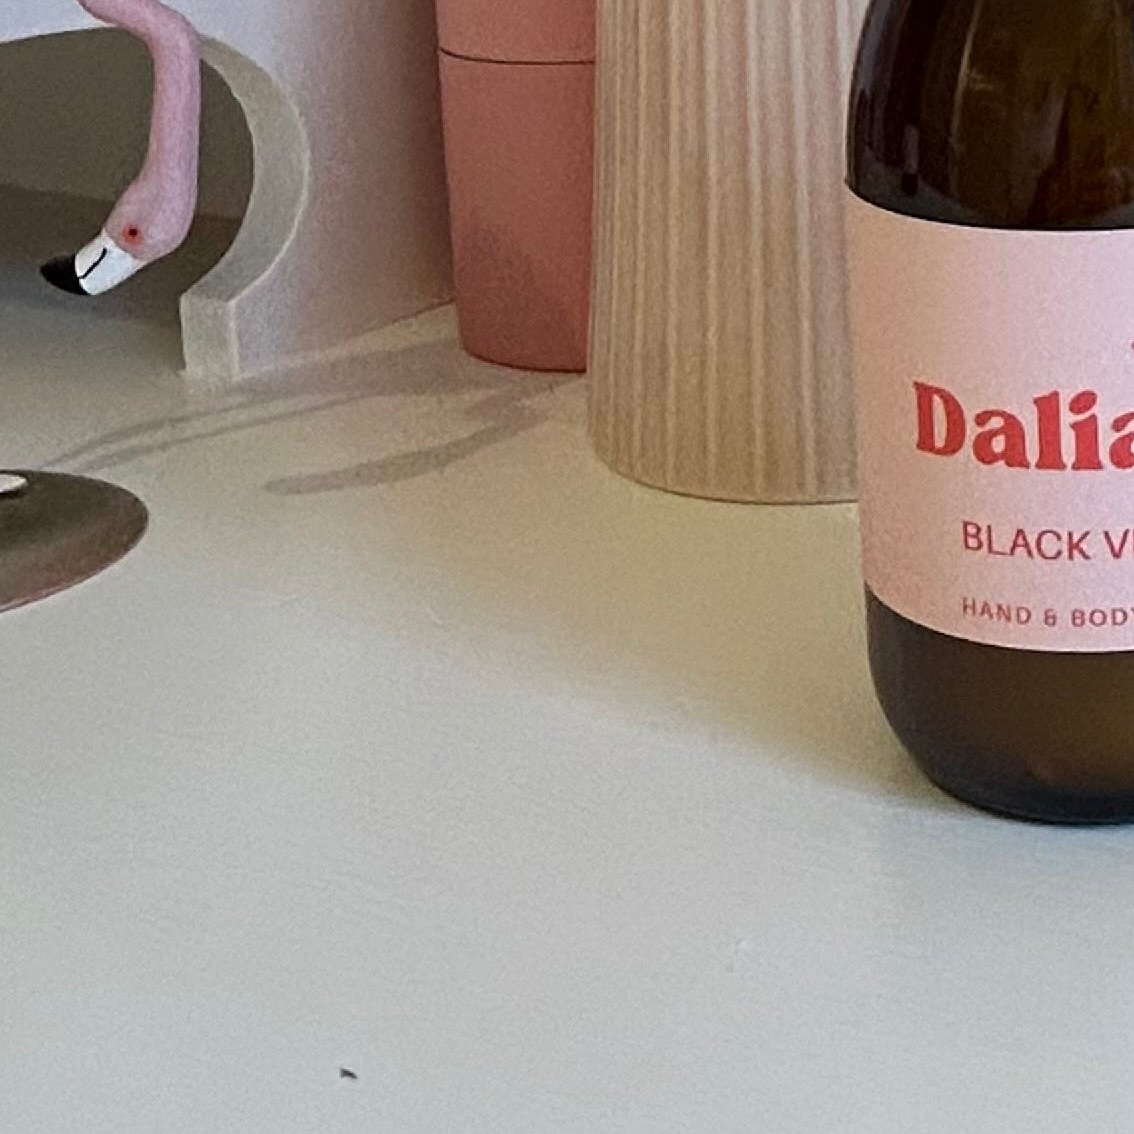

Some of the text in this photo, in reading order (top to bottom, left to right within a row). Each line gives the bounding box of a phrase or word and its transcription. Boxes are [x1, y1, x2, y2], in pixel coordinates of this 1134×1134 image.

[962, 520, 1090, 561] BLACK
[962, 597, 1031, 625] HAND
[1043, 609, 1057, 627] &
